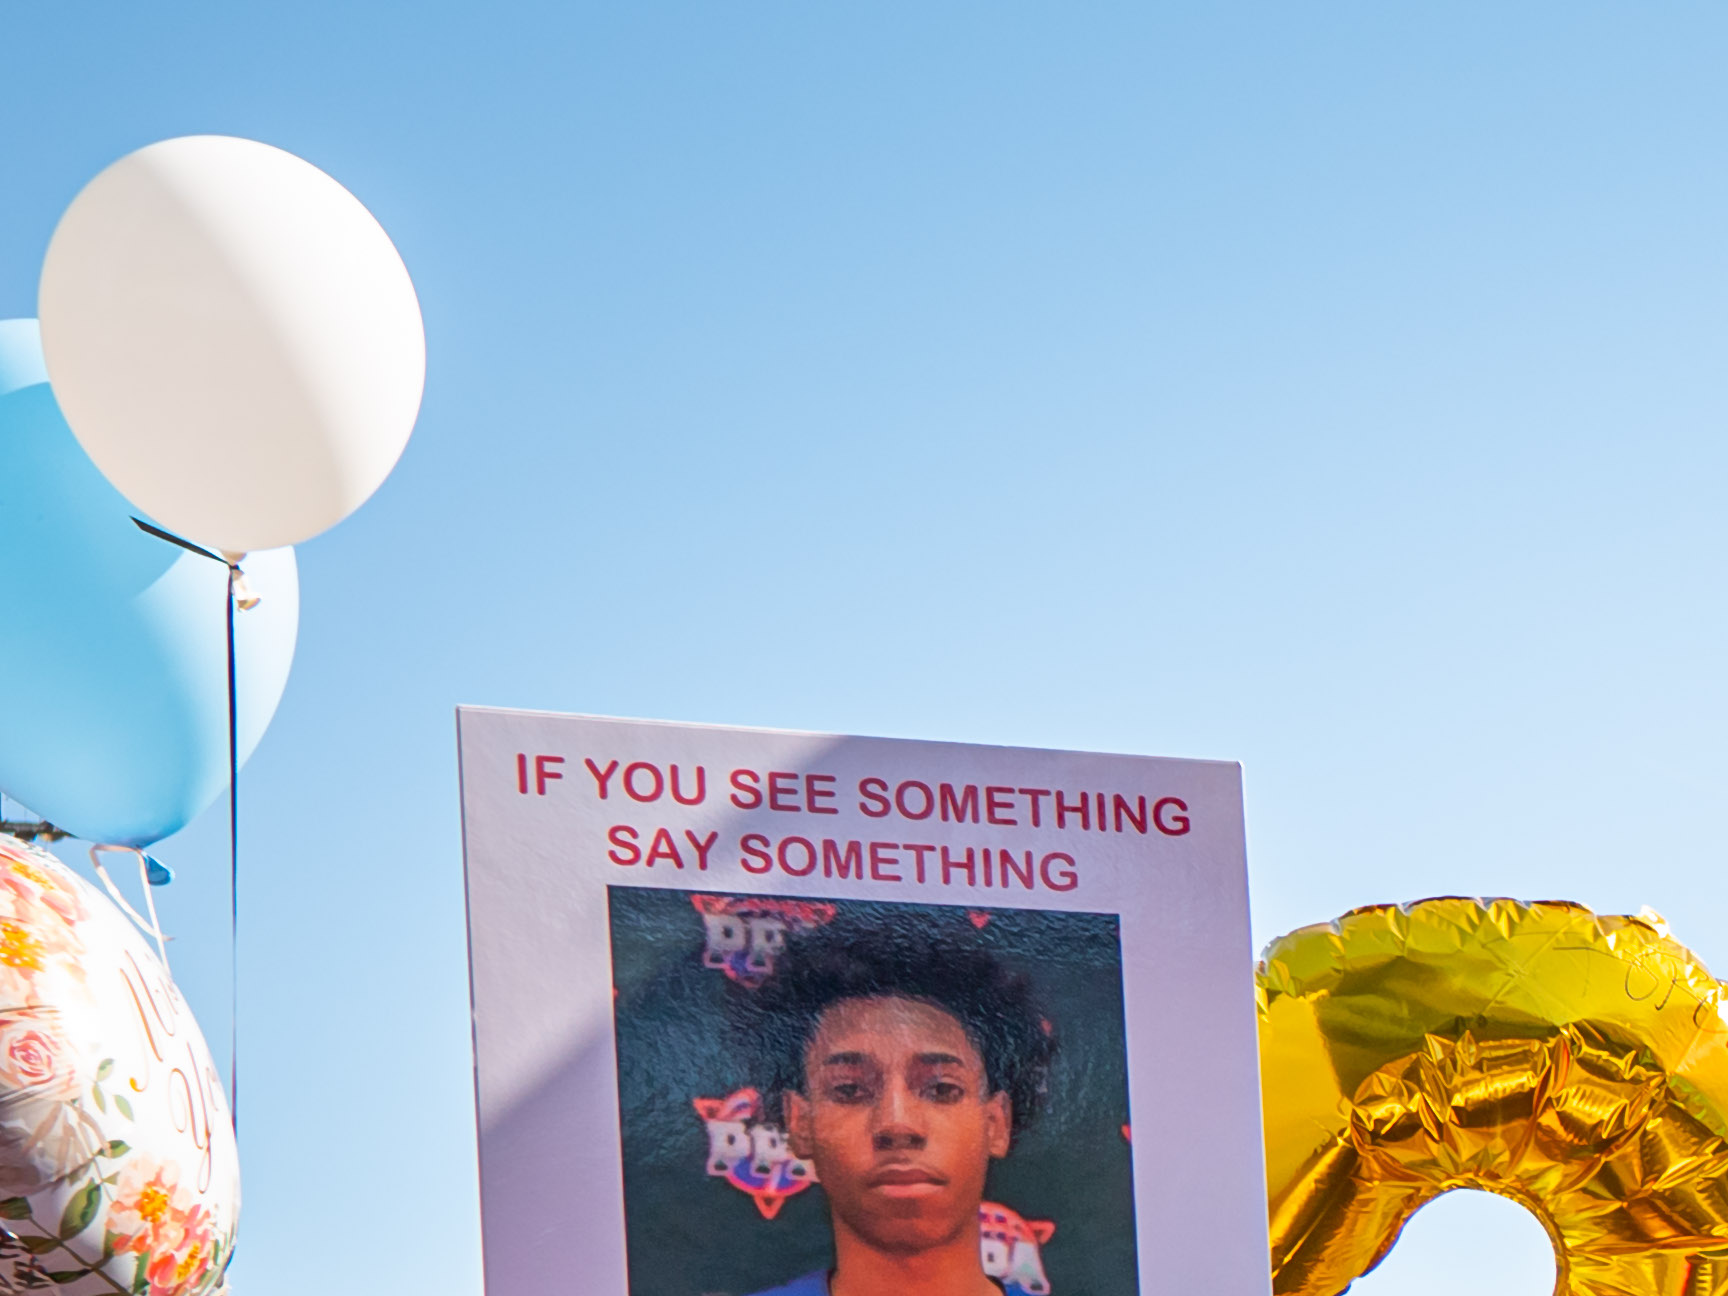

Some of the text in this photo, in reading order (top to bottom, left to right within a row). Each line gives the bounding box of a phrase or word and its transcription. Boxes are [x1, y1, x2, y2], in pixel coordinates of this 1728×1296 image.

[515, 753, 1191, 838] IF YOU SEE SOMETHING
[607, 825, 1080, 893] SAY SOMETHING
